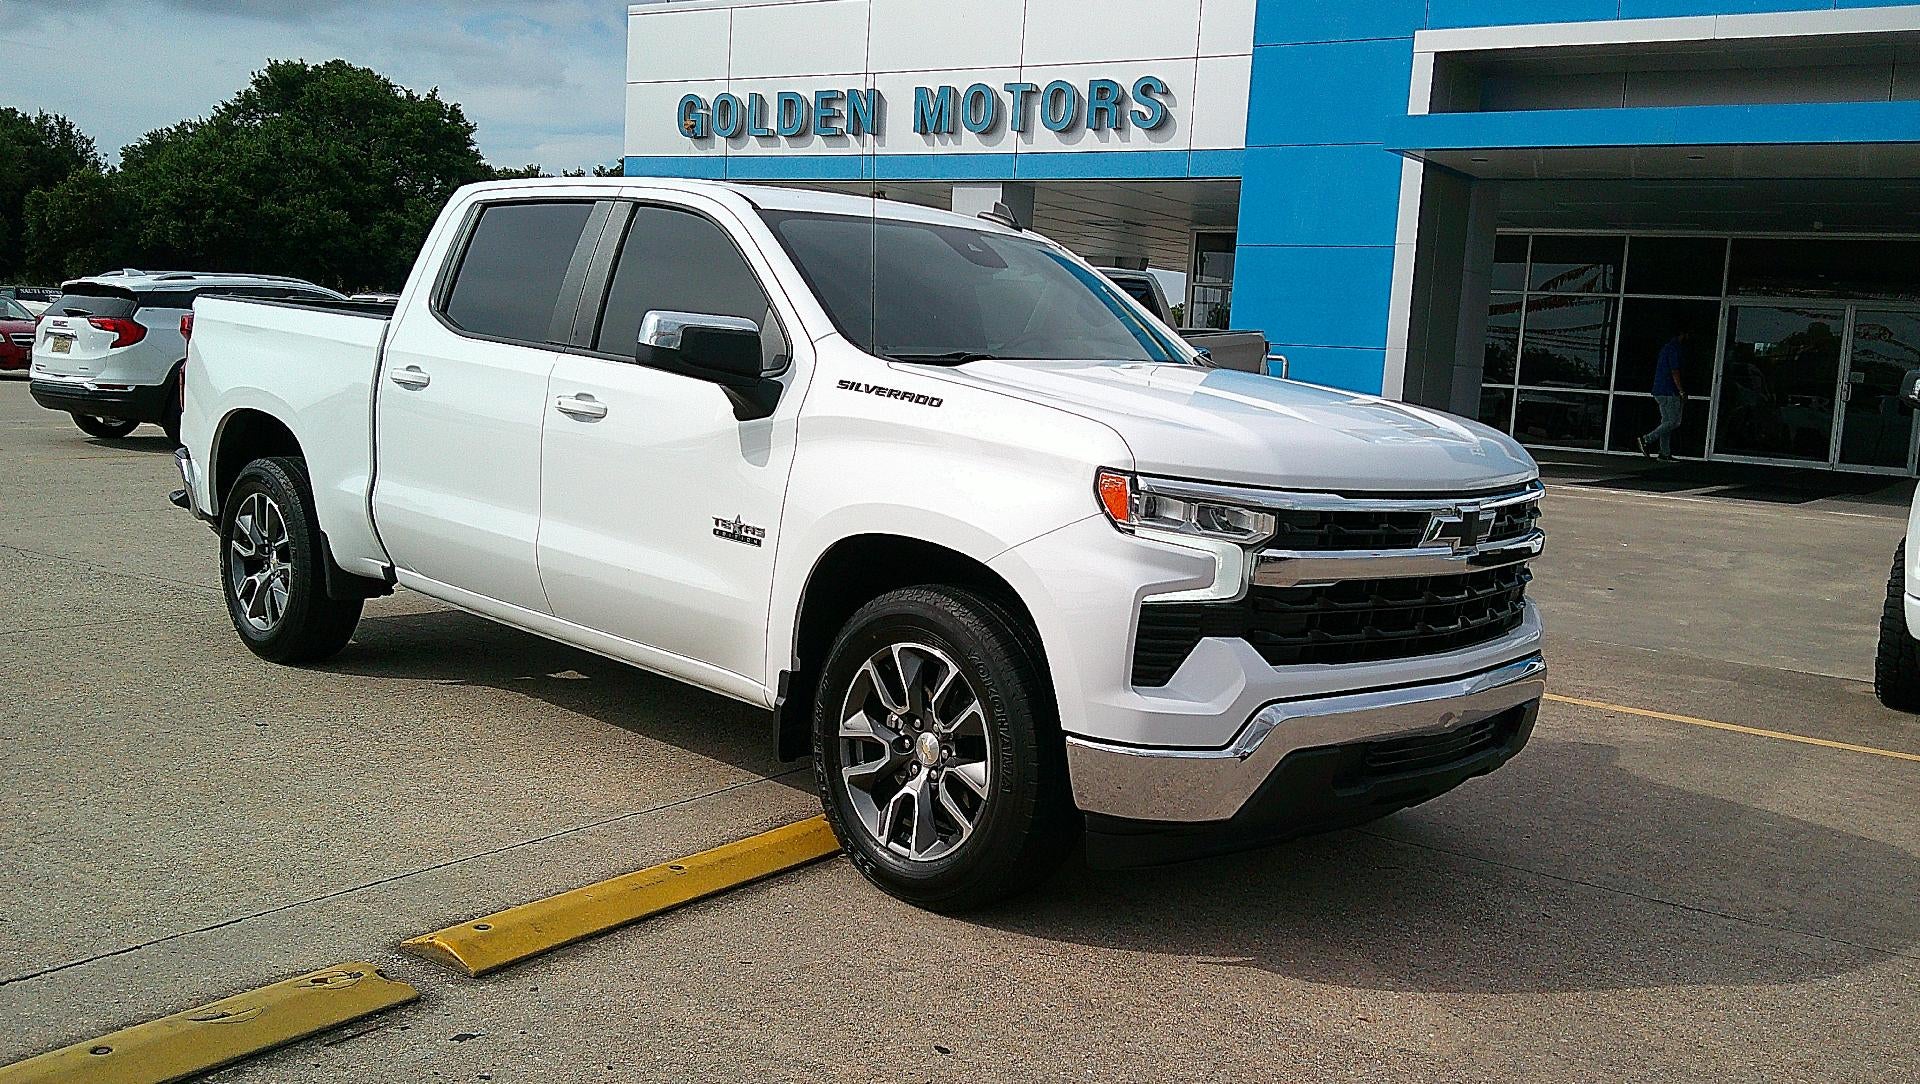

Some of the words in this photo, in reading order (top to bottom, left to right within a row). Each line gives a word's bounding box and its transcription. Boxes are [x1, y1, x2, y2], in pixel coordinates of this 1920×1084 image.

[677, 88, 880, 139] GOLDEN
[913, 75, 1169, 134] MOTORS
[837, 379, 943, 408] SILVERADO
